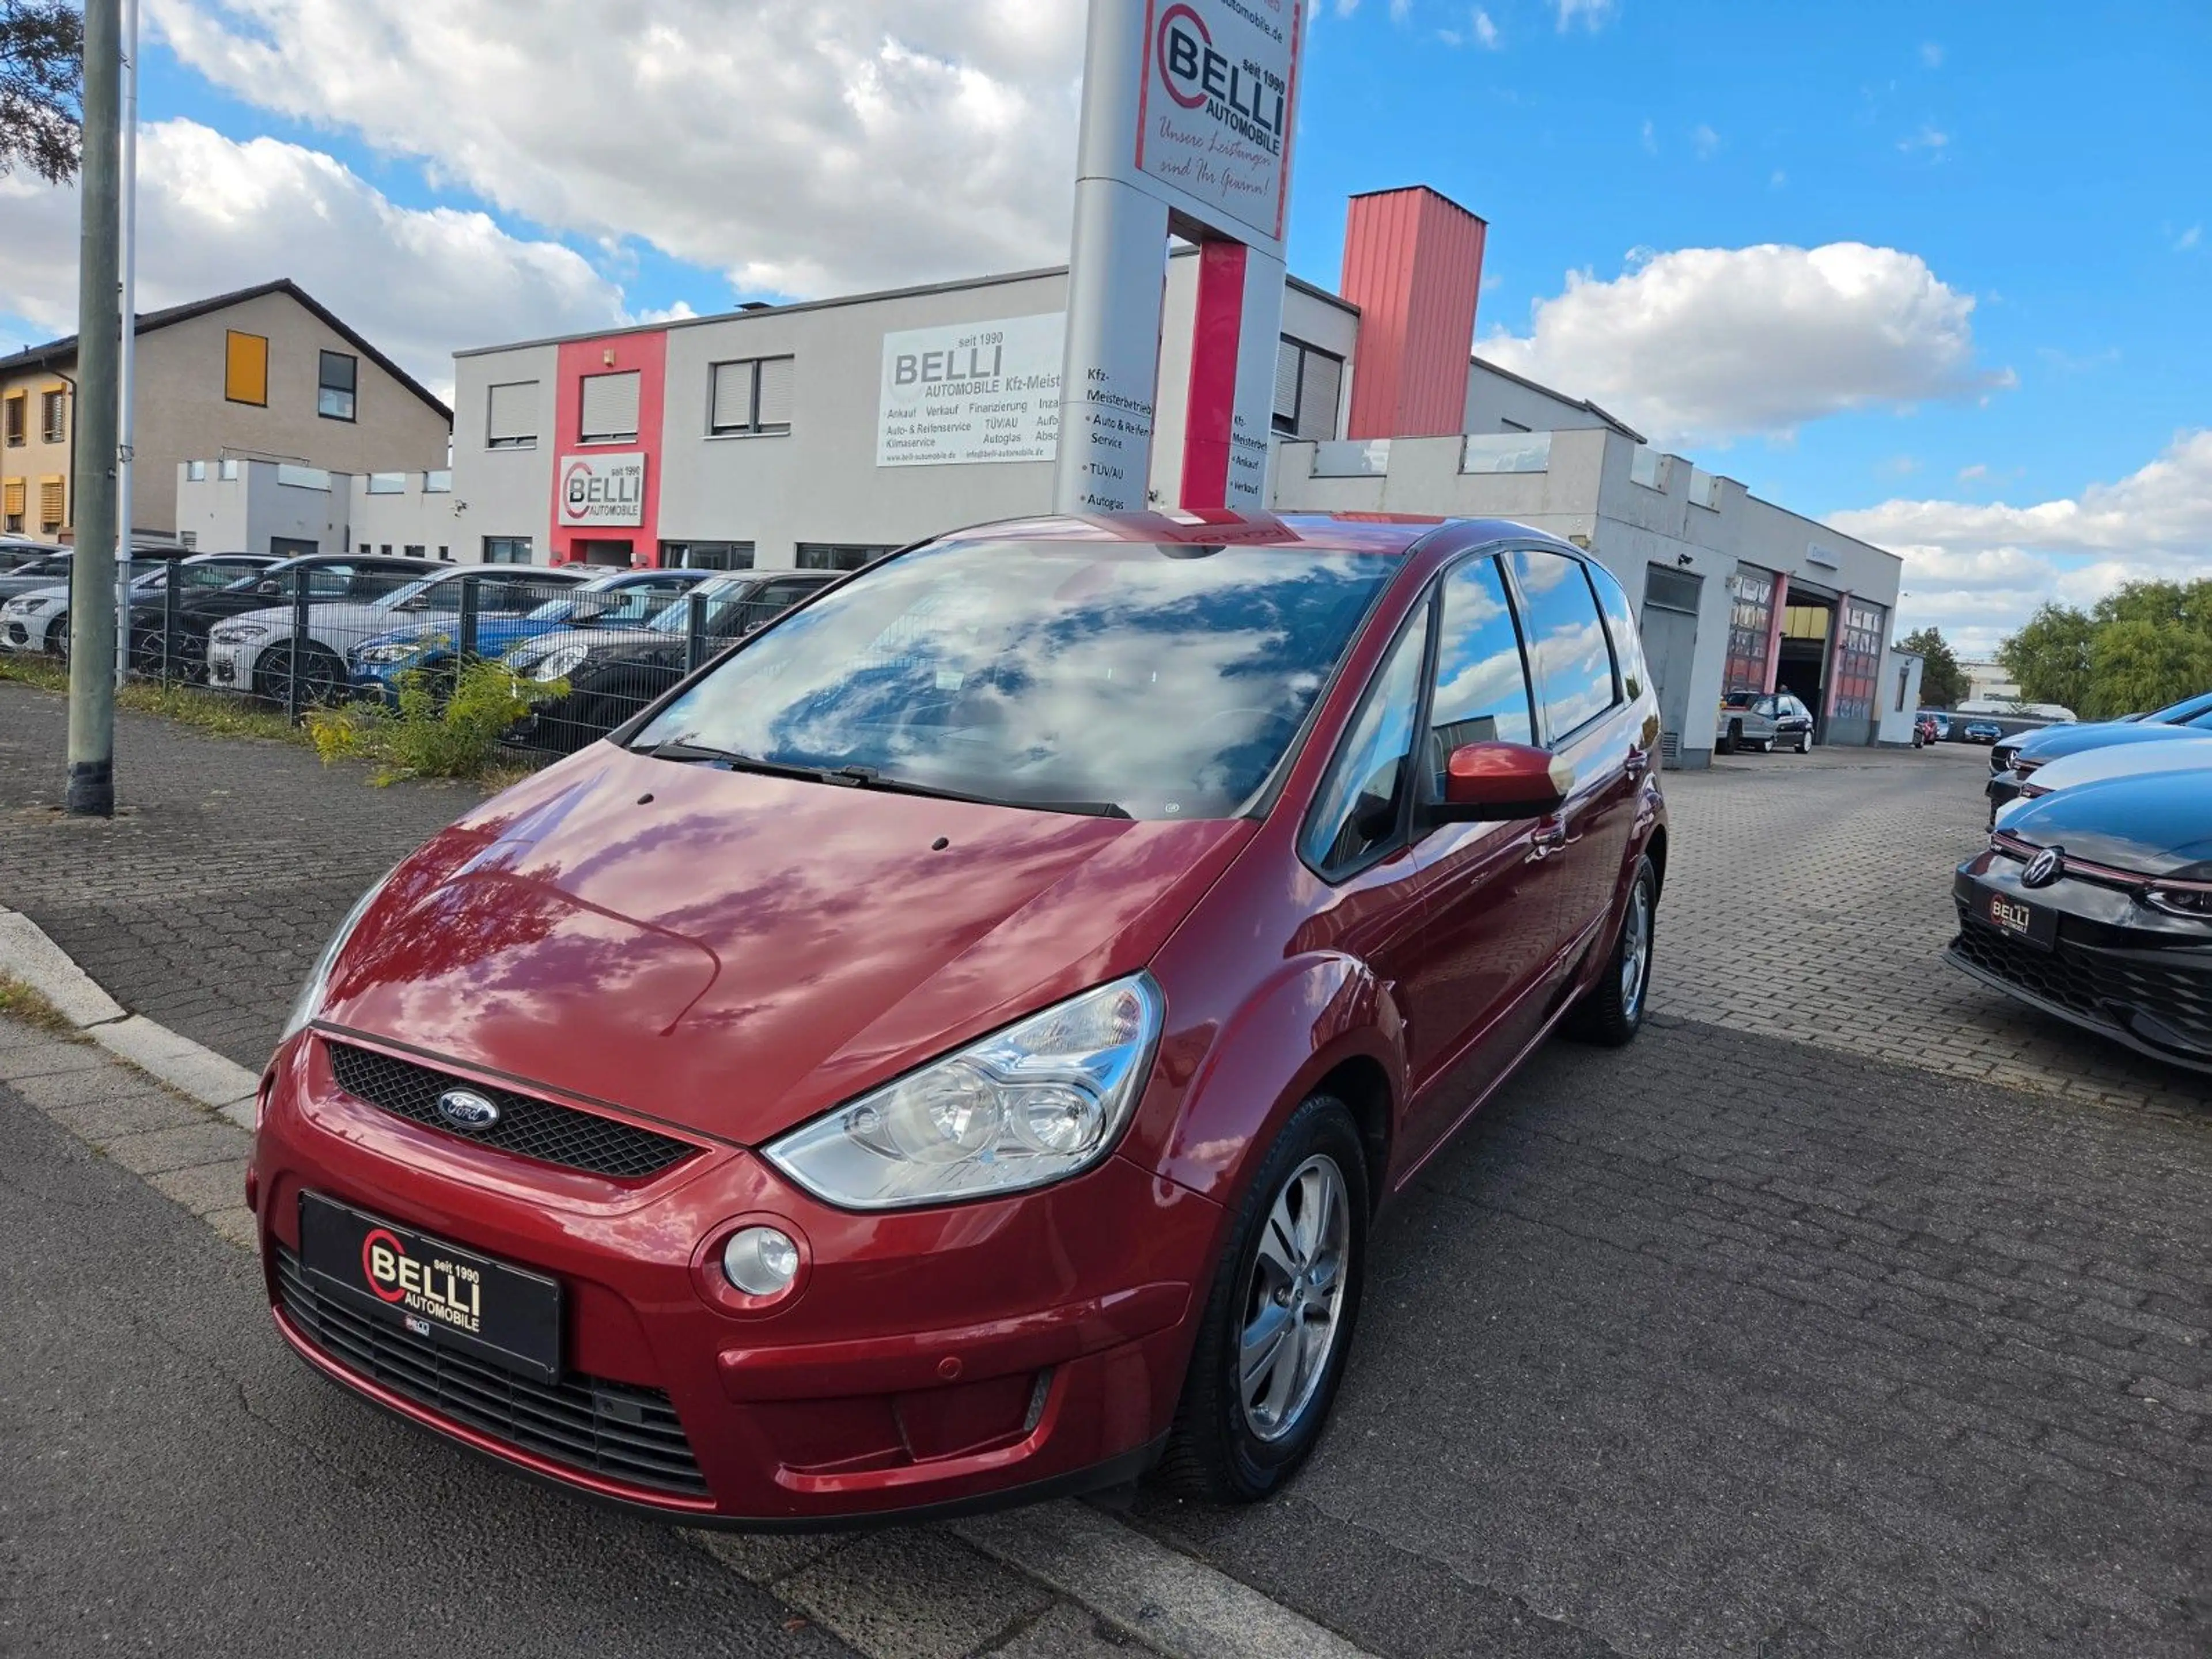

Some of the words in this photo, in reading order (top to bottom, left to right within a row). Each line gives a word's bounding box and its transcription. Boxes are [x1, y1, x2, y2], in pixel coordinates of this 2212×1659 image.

[1169, 26, 1284, 136] BELLI
[1243, 59, 1261, 79] seit
[1263, 70, 1285, 96] 1990
[1160, 116, 1204, 147] Unsere
[1206, 98, 1280, 157] AUTOMOBILE
[1160, 157, 1191, 176] sind
[1196, 158, 1216, 184] Ihr
[958, 334, 976, 347] seit
[980, 332, 1003, 346] 1990
[895, 345, 1002, 385] BELLI
[1088, 368, 1109, 381] Kfz-
[925, 380, 1000, 397] AUTOMOBILE
[887, 407, 916, 419] Ankauf
[926, 404, 959, 417] Verkauf
[969, 401, 1028, 414] Finanzierung
[1086, 389, 1152, 415] Meisterbetrieb
[916, 423, 972, 434] Reifenservice
[1093, 414, 1116, 429] Auto
[1117, 419, 1124, 431] &
[886, 437, 936, 448] Klimaservice
[983, 432, 1021, 445] Autoglas
[1090, 433, 1122, 449] Service
[569, 476, 639, 503] BELLI
[589, 504, 638, 516] AUTOMOBILE
[1088, 494, 1124, 511] Autoglas
[1993, 901, 2029, 927] BELLI
[447, 1096, 483, 1121] Ford
[372, 1245, 480, 1317] BELLI
[433, 1259, 453, 1274] seit
[454, 1264, 480, 1284] 1990
[405, 1292, 480, 1333] AUTOMOBILE
